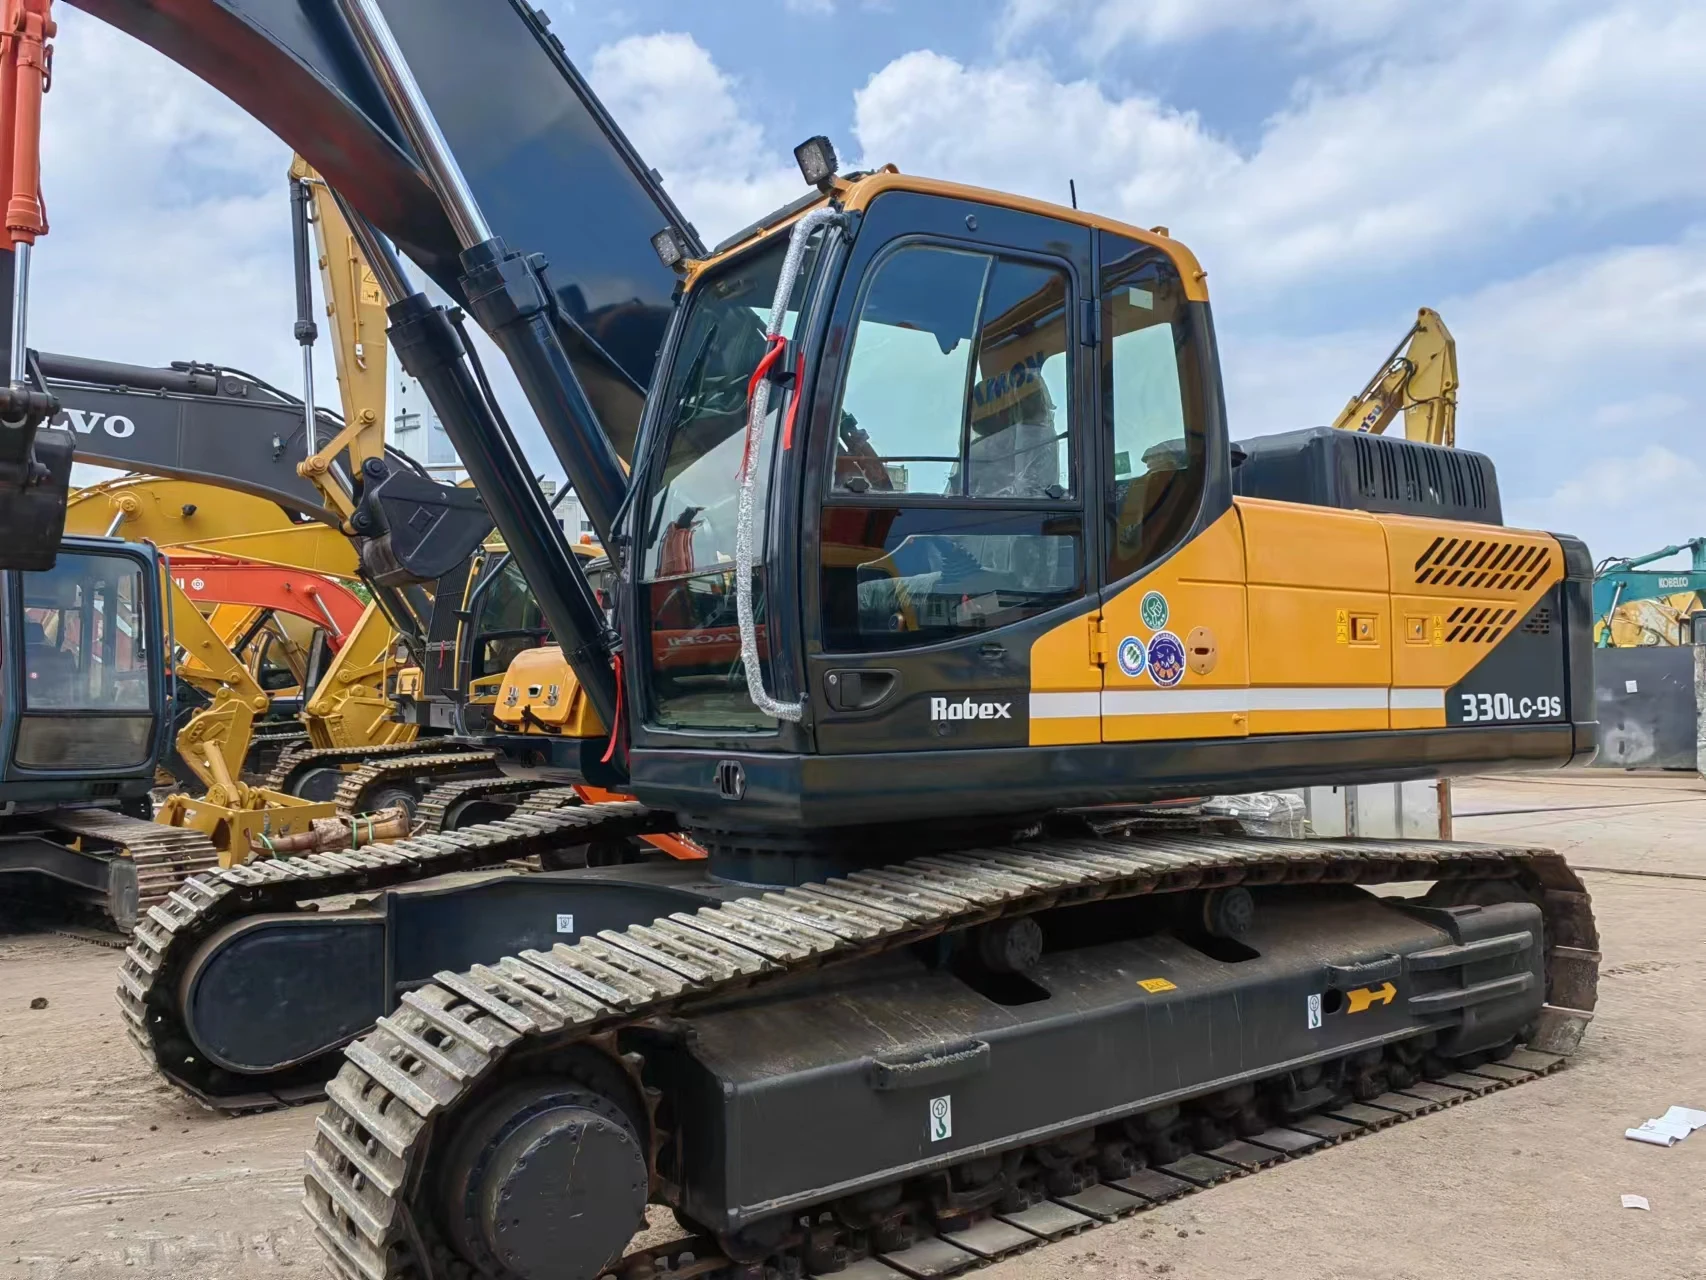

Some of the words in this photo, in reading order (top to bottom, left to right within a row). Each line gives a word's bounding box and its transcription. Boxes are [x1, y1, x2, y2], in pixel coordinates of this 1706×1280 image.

[1658, 576, 1689, 588] KOBELCO
[930, 696, 1012, 721] Robex
[1461, 692, 1562, 722] 330LC-9S
